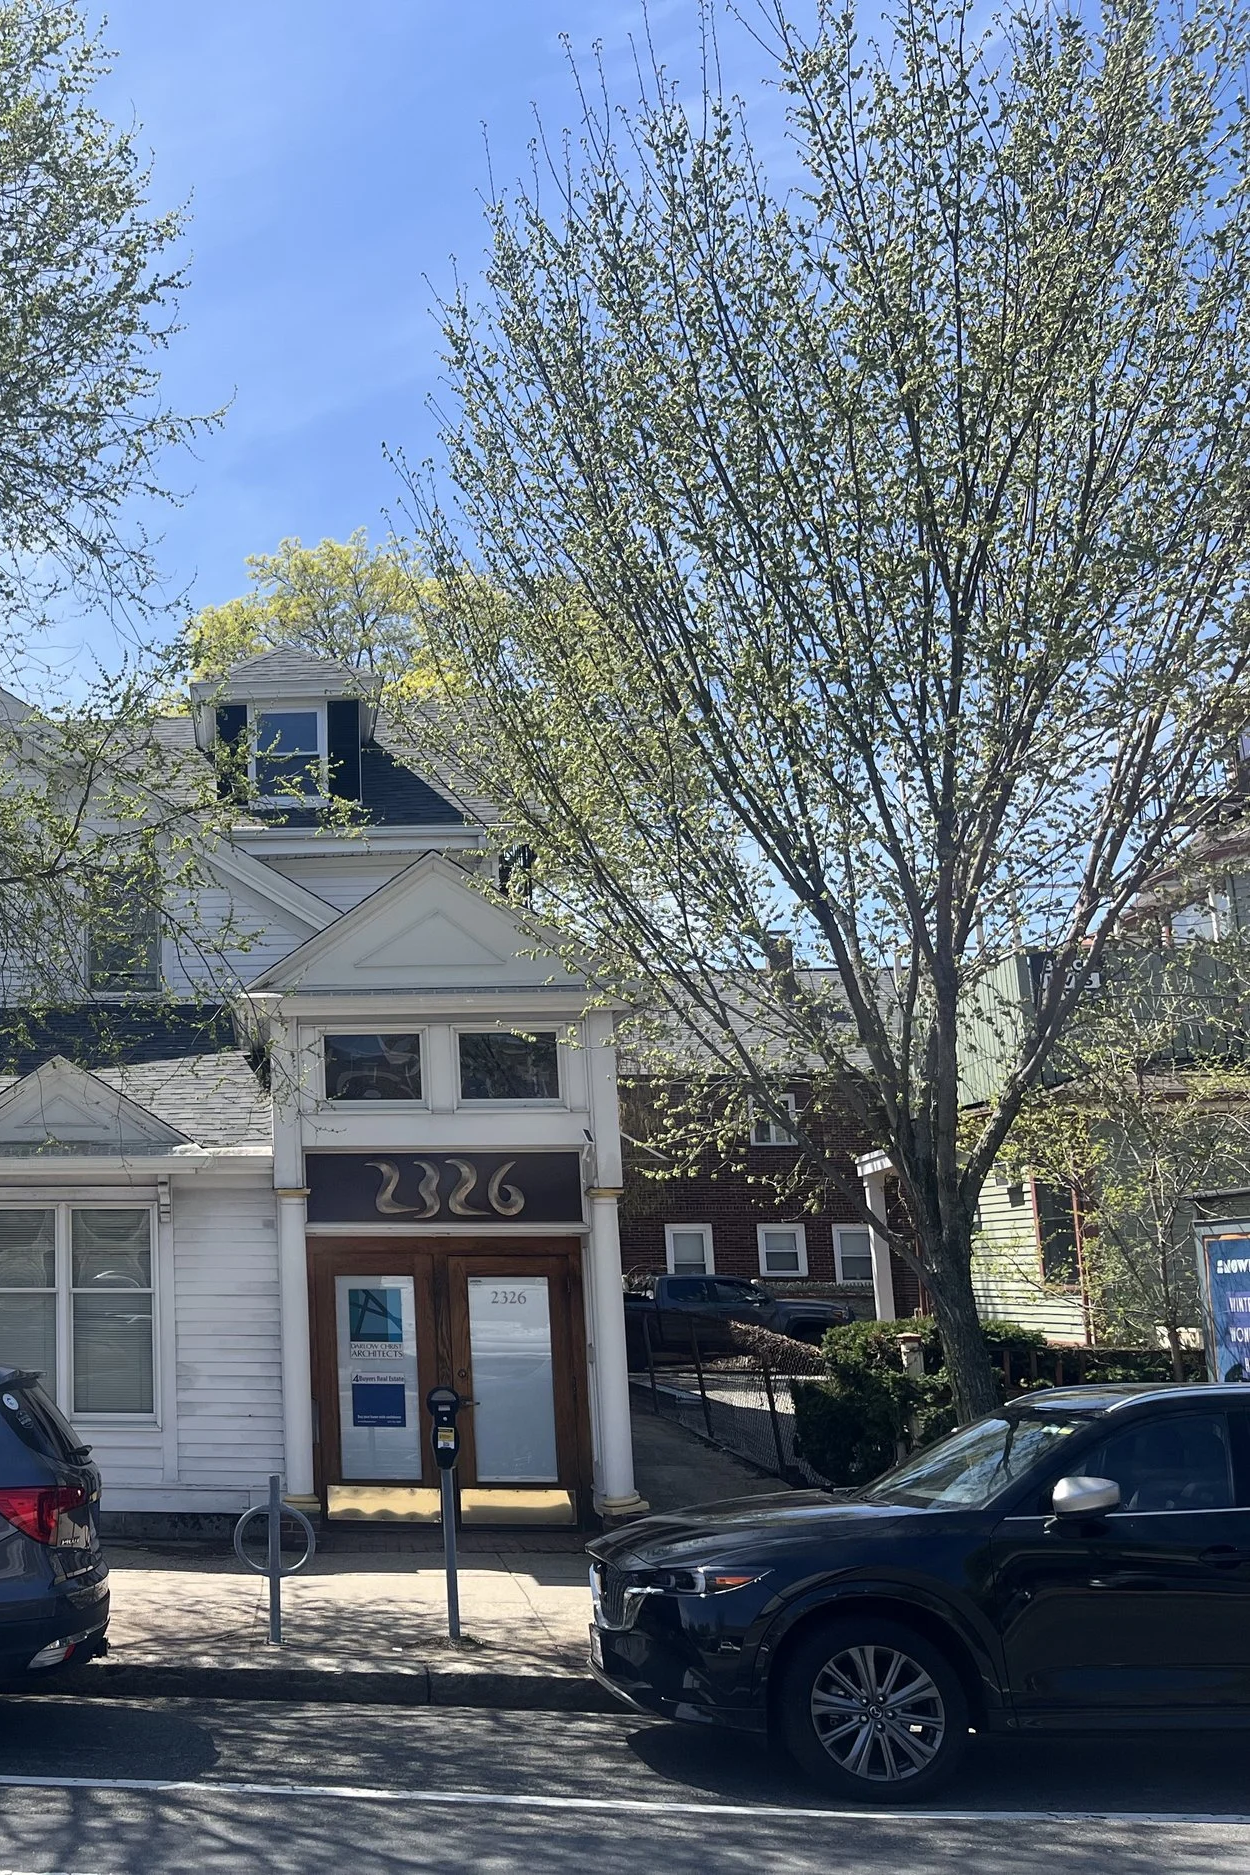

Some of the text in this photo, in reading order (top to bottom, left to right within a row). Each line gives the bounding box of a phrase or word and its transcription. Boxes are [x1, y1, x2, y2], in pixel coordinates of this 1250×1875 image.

[364, 1158, 526, 1219] 2326
[490, 1290, 527, 1304] 2326
[351, 1350, 403, 1358] ARCHITECTS
